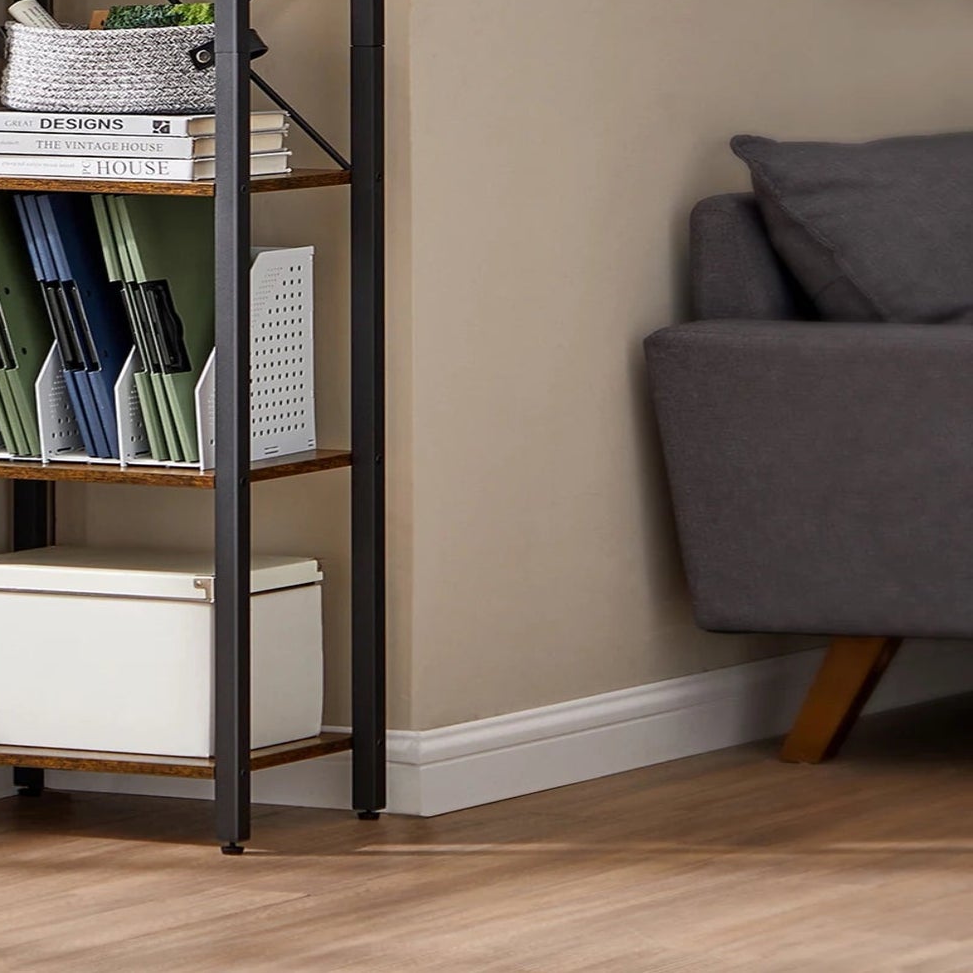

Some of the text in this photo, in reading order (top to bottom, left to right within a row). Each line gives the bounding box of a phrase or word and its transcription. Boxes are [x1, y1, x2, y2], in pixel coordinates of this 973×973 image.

[4, 117, 124, 131] GREAT DESIGNS
[35, 139, 164, 153] THE VINTAGE HOUSE
[96, 159, 171, 176] HOUSE
